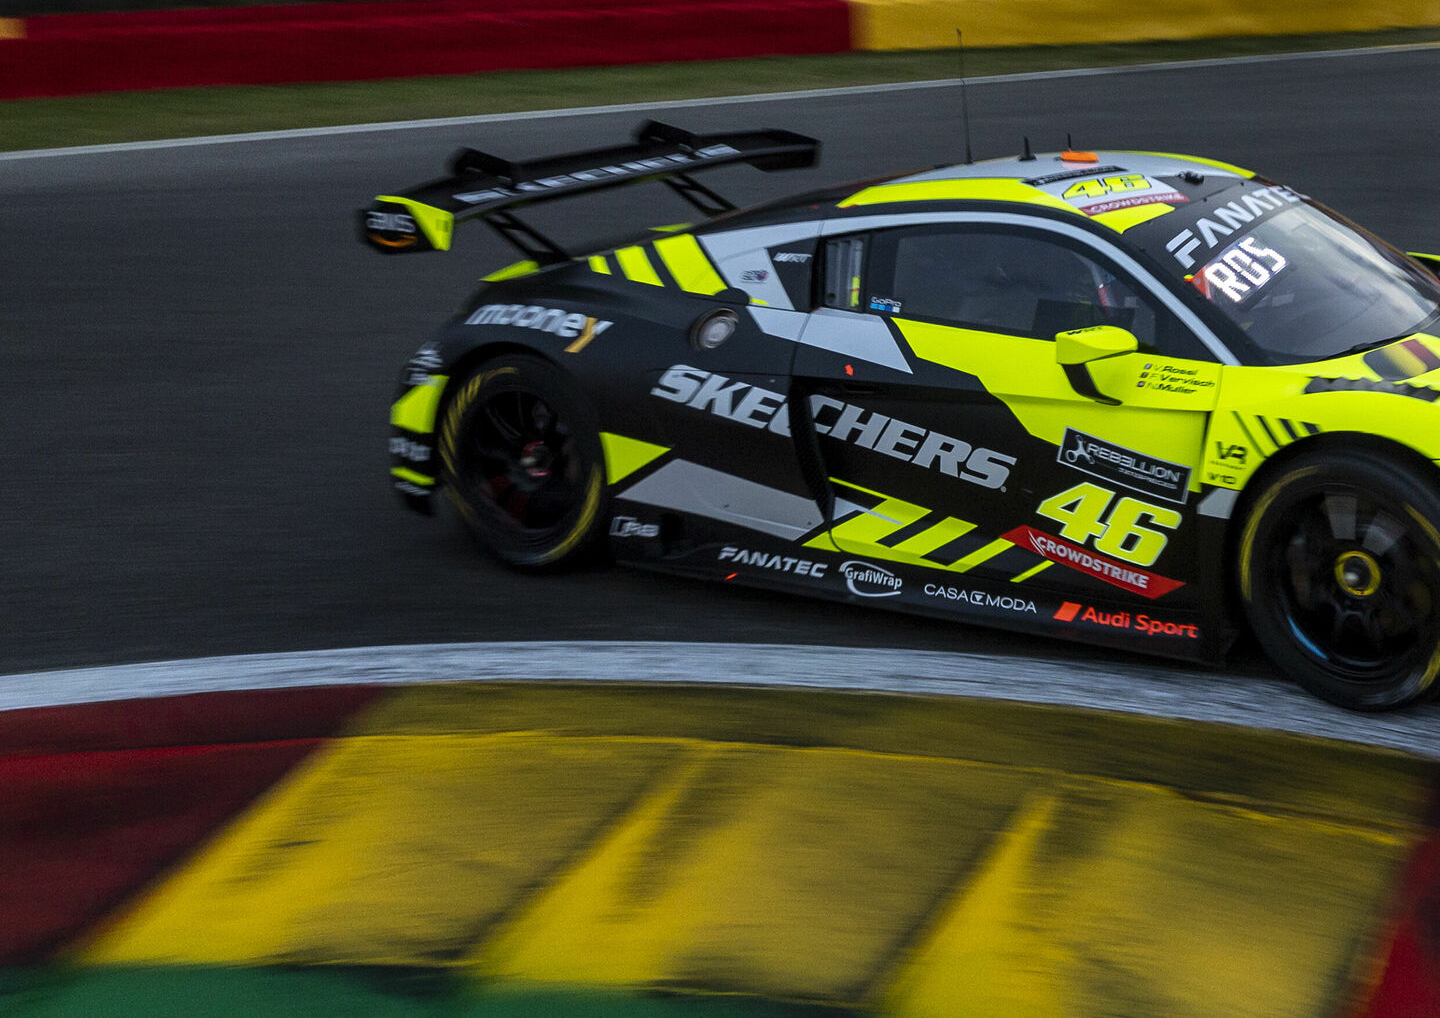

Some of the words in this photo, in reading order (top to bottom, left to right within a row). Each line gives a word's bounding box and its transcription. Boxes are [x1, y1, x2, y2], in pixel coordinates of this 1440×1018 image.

[1062, 174, 1152, 199] 46
[773, 253, 813, 263] WRT
[871, 296, 902, 308] GoPro
[464, 304, 614, 353] mooney
[651, 364, 1018, 491] SKECHERS
[1086, 442, 1183, 483] REBELLION
[1035, 481, 1182, 567] 46
[717, 546, 829, 579] FANATEC
[844, 565, 903, 591] GrafiWrap
[1036, 535, 1149, 589] CROWDSTRIKE
[1081, 606, 1130, 629] Audi
[1134, 614, 1199, 639] Sport
